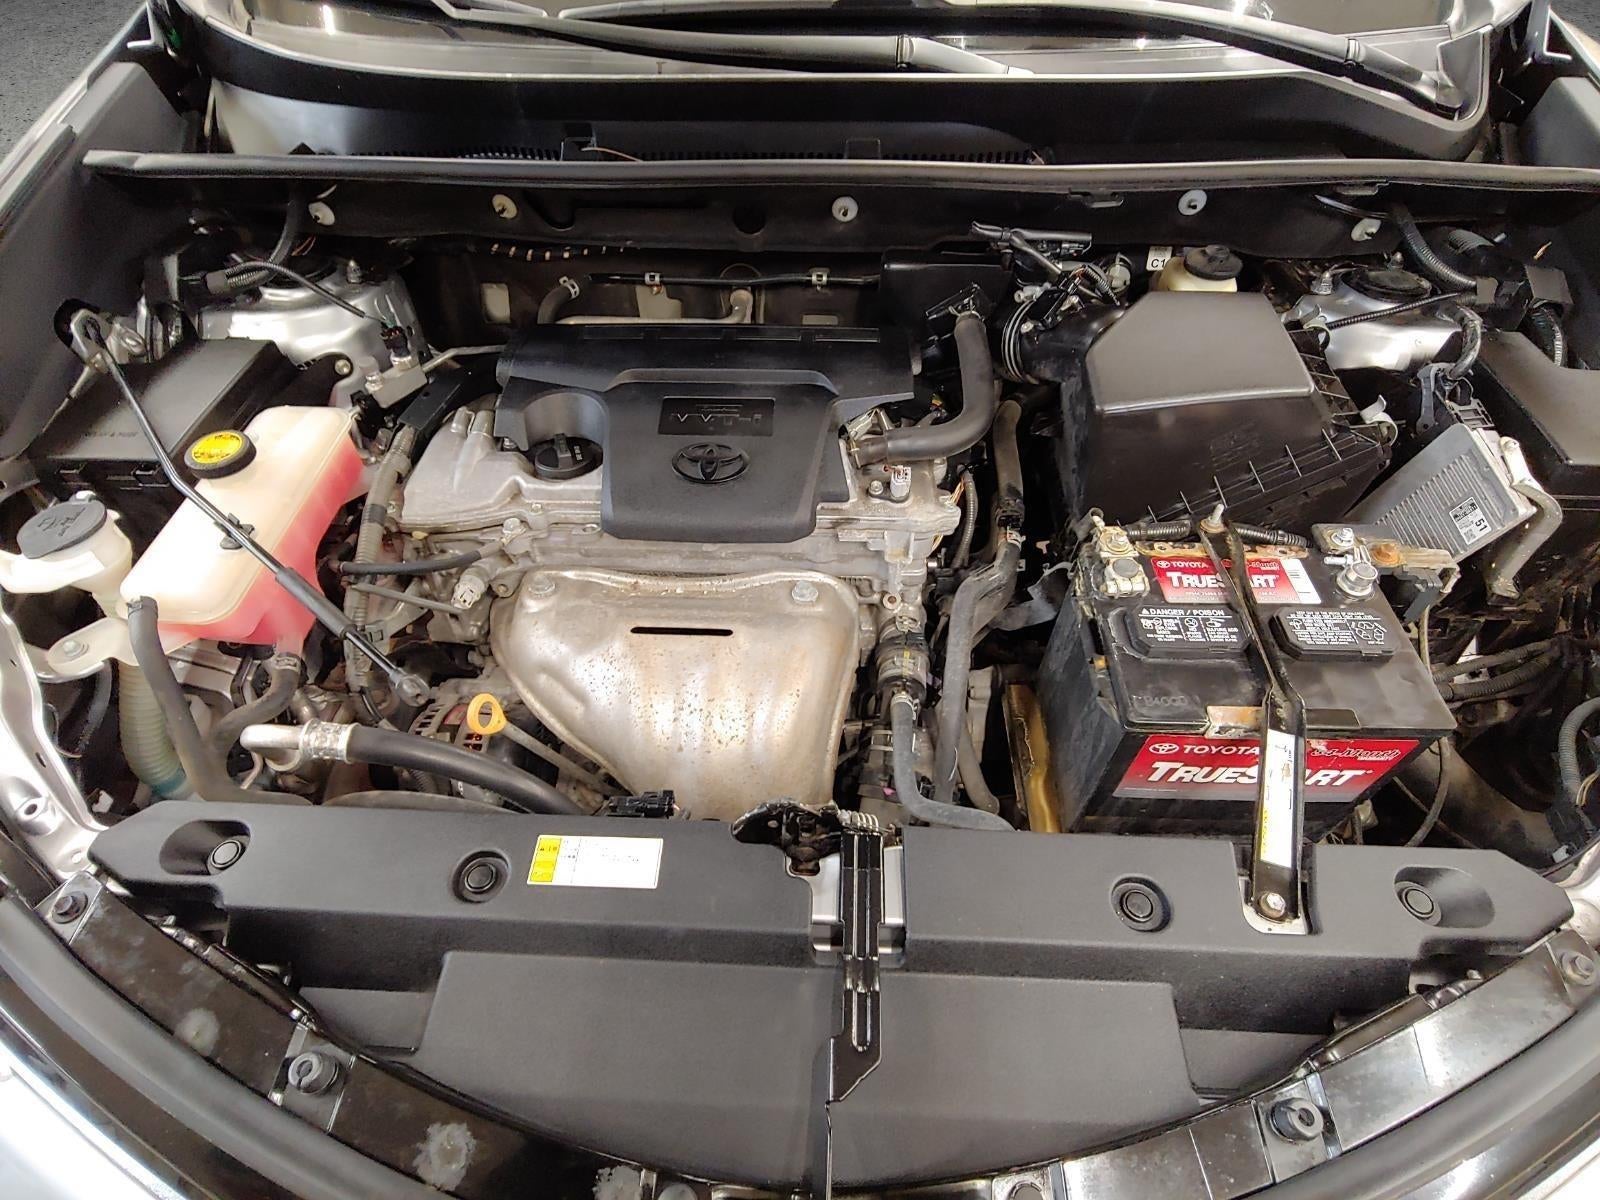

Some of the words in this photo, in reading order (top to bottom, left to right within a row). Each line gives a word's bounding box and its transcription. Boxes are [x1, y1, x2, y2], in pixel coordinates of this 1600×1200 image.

[1474, 518, 1488, 532] 51
[1170, 561, 1209, 569] TOYOTA
[1183, 744, 1260, 755] TOYOTA
